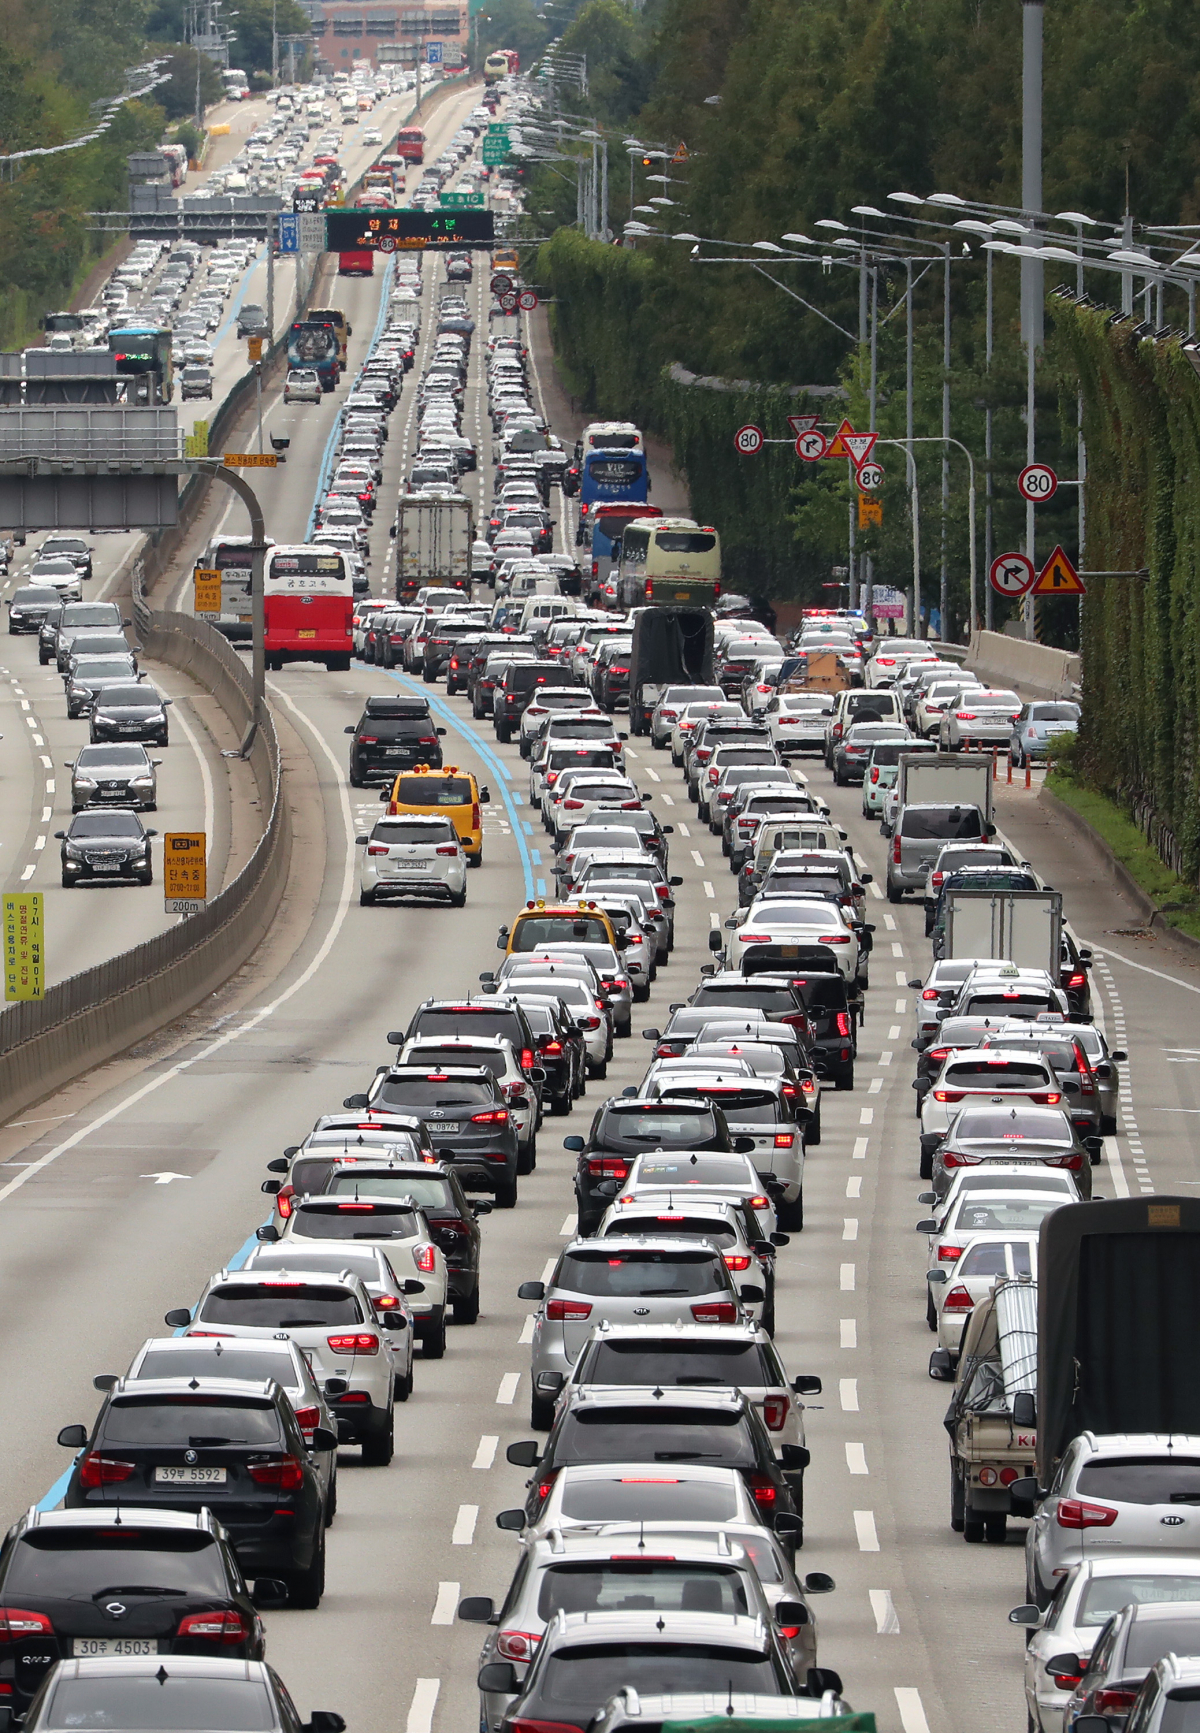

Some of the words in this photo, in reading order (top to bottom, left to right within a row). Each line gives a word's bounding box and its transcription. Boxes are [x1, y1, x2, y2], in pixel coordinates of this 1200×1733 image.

[381, 240, 394, 248] 80
[740, 433, 758, 448] 80
[606, 463, 625, 472] VIP
[1026, 474, 1050, 493] 80
[172, 901, 199, 912] 200m
[436, 1123, 456, 1131] 0876
[1018, 1435, 1036, 1447] KI
[190, 1469, 221, 1481] 5592
[80, 1640, 108, 1654] 30주
[114, 1640, 151, 1655] 4503
